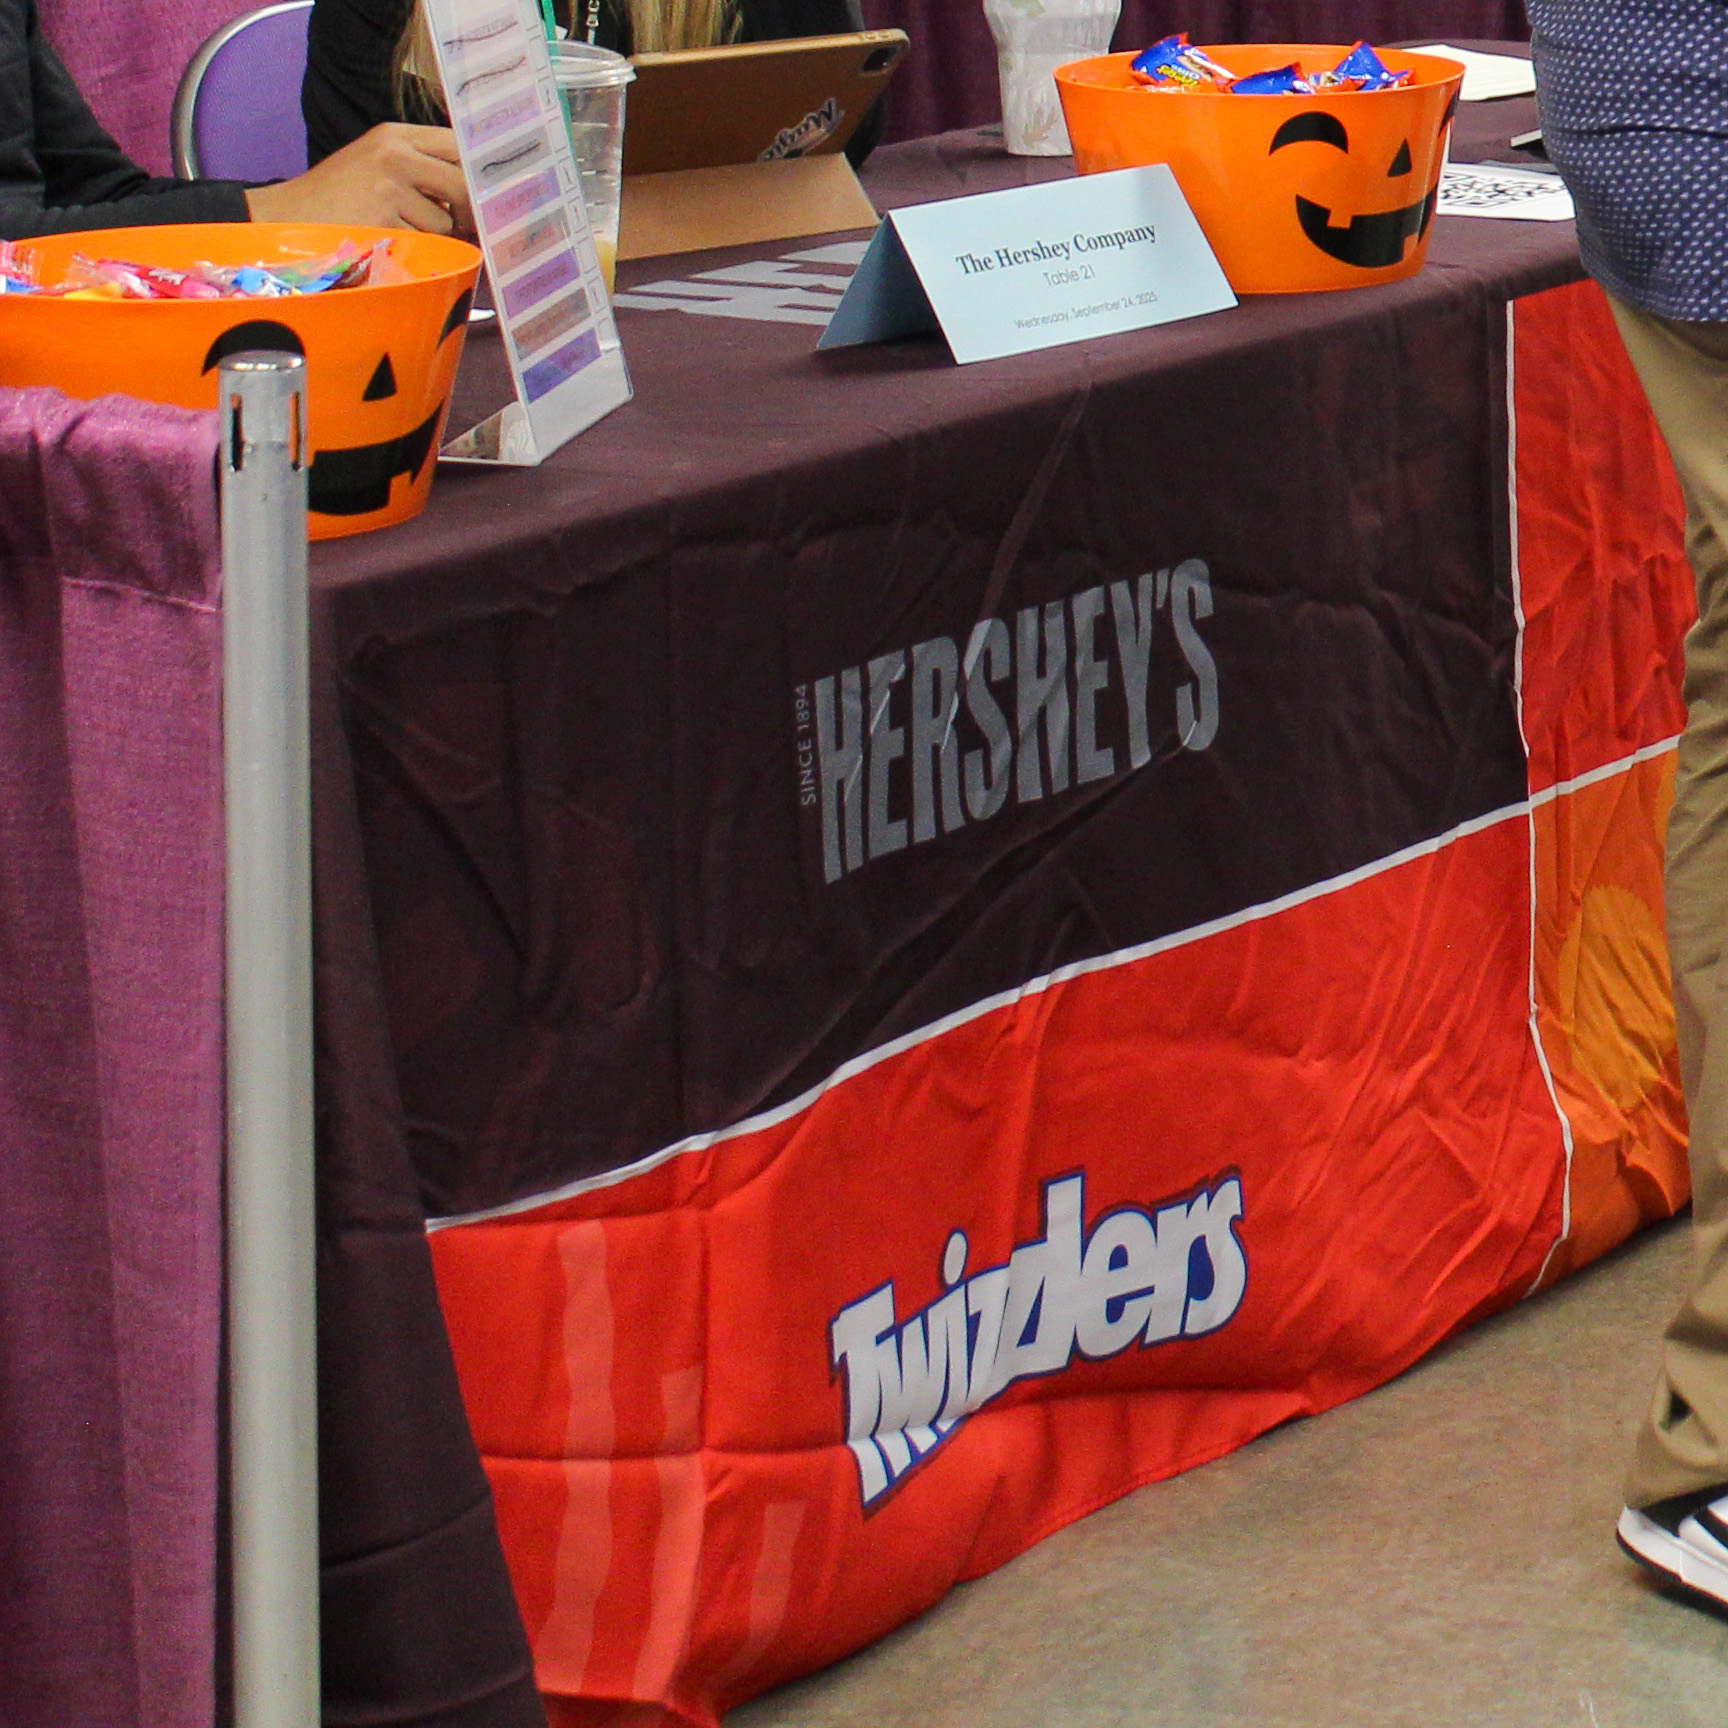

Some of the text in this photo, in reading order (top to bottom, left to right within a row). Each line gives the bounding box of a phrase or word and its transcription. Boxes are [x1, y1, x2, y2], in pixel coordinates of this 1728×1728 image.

[955, 225, 1157, 275] The Hershey Company
[1042, 263, 1096, 287] Table 21
[1070, 299, 1121, 320] September
[795, 682, 816, 806] SINCE 1894
[814, 558, 1219, 885] HERSHEY'S
[831, 1173, 1248, 1509] Twizzlers
